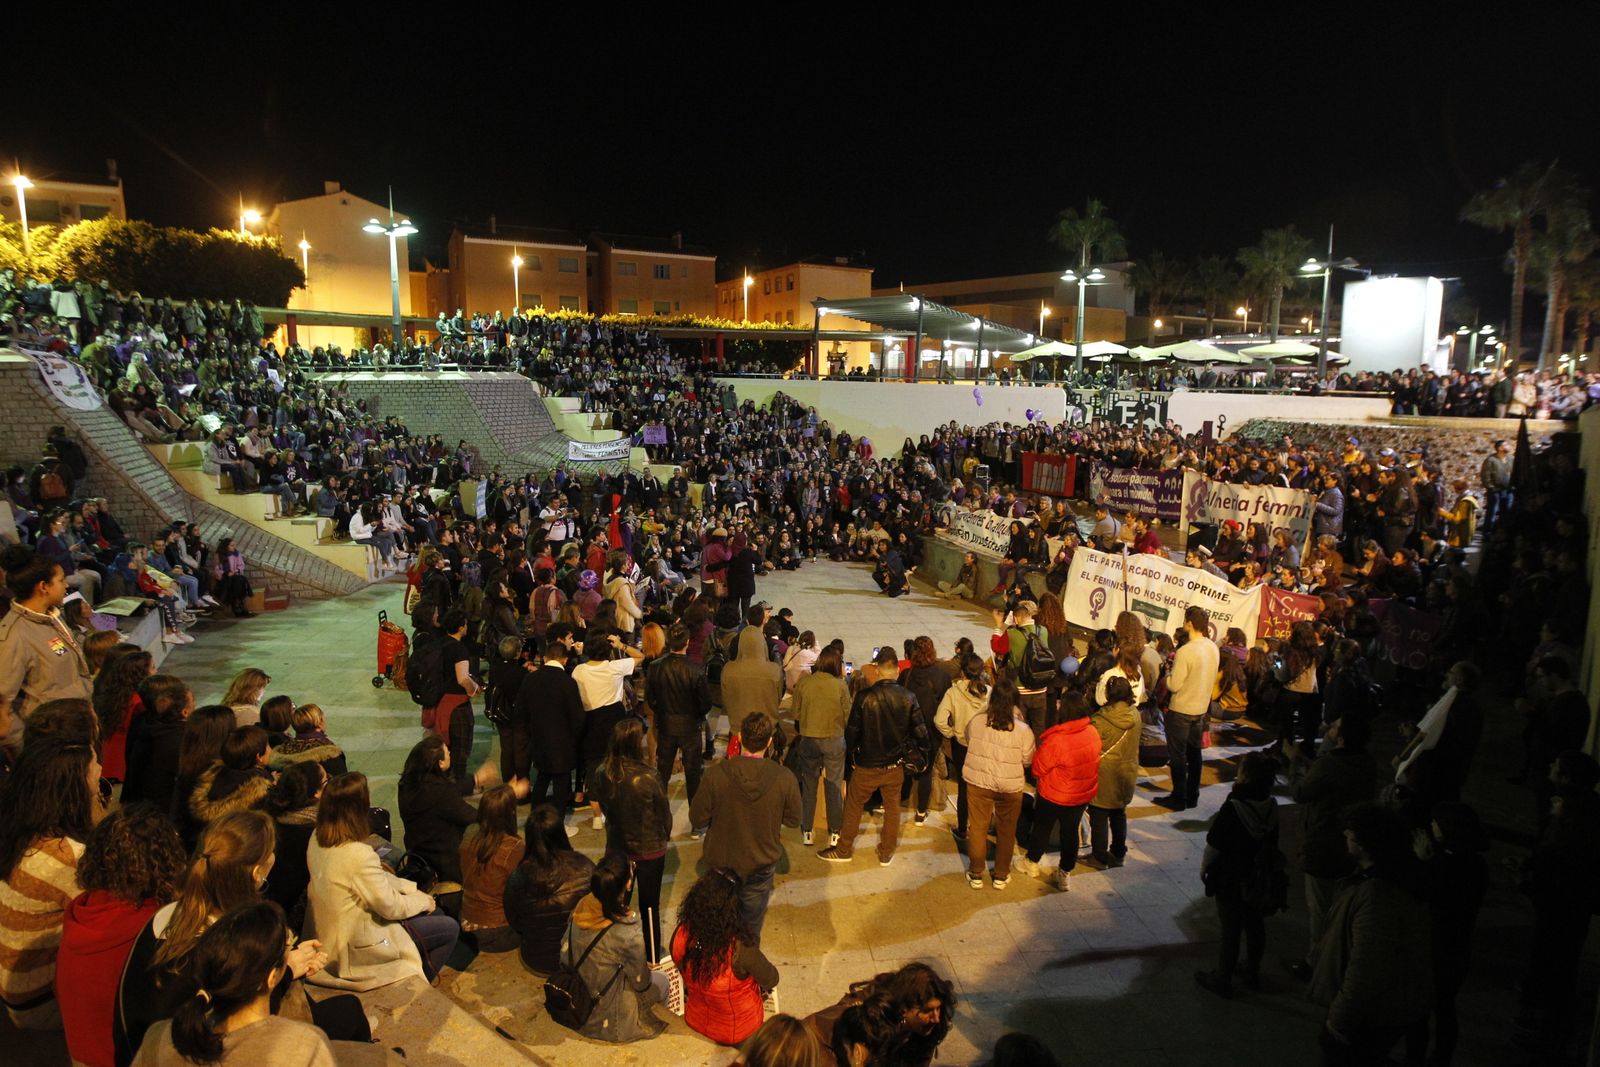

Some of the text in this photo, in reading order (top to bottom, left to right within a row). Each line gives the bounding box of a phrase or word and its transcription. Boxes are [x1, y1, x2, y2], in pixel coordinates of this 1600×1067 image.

[1080, 571, 1090, 580] EL
[1093, 575, 1141, 595] FEMINISMO
[1144, 590, 1162, 602] NOS
[1100, 557, 1161, 580] PATRIRCADO
[1164, 574, 1184, 587] NOS
[1187, 581, 1231, 605] OPRIME,
